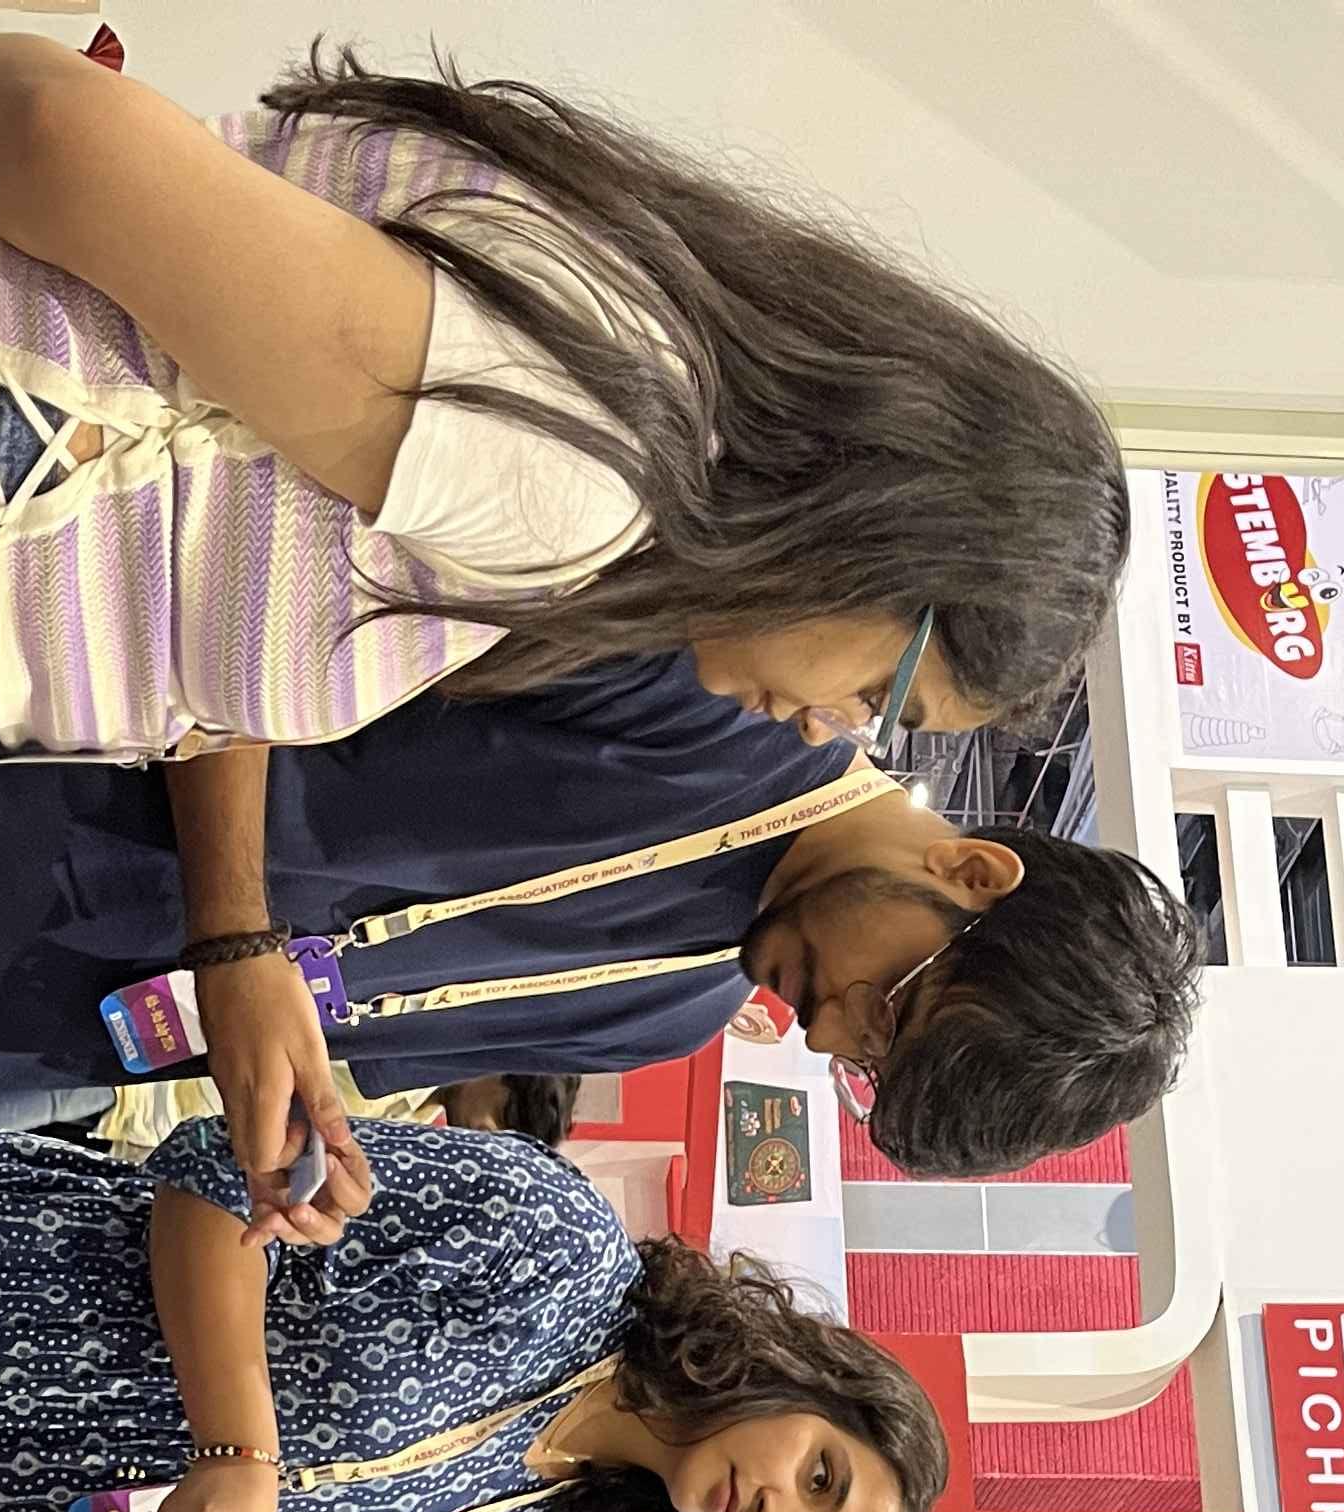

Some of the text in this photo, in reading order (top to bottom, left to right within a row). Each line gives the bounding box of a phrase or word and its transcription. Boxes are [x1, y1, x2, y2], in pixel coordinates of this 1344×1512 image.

[1169, 530, 1190, 607] PRODUCT
[1178, 613, 1192, 635] BY
[764, 817, 788, 833] TOY
[601, 864, 633, 876] INDIA
